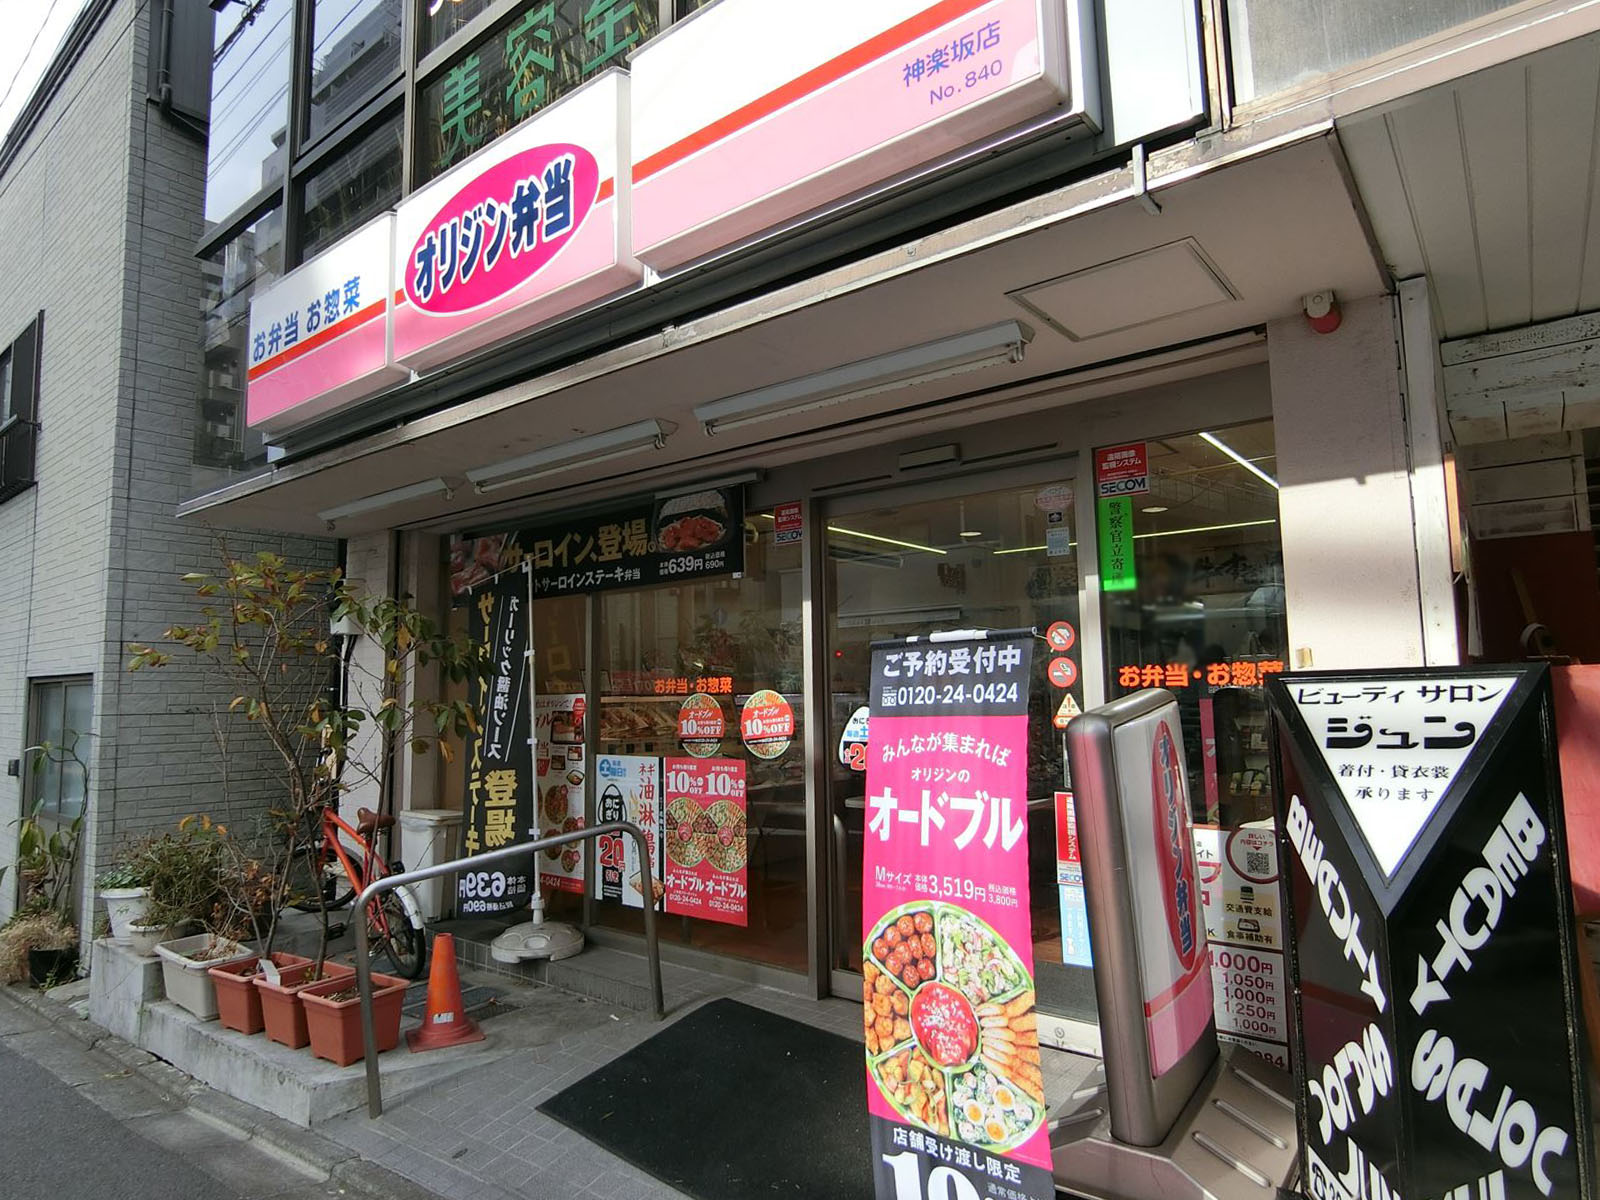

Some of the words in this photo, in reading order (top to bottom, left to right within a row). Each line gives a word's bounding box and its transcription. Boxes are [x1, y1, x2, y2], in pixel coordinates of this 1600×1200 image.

[902, 20, 1000, 87] 神楽坂店
[929, 59, 1002, 105] No.840
[413, 153, 576, 302] オリジン弁当
[252, 315, 299, 362] お弁当
[305, 275, 361, 330] お惣菜
[1101, 478, 1146, 494] SECOM
[668, 556, 703, 573] 639円
[883, 645, 1021, 677] ご予約受付中
[654, 677, 733, 694] お弁当・お惣菜
[898, 682, 1018, 705] 0120-24-0424
[1297, 686, 1405, 705] ビューティ
[1417, 684, 1503, 703] サロン
[1326, 716, 1476, 749] ジュン
[882, 732, 1011, 767] みんなが集まれば
[911, 767, 971, 783] オリジンの
[1355, 786, 1434, 801] 承ります
[868, 786, 1025, 851] オードブル
[1160, 733, 1193, 956] オリジン弁当
[875, 865, 912, 885] Mサイズ
[1060, 873, 1081, 882] SECO
[705, 879, 747, 898] オードブル
[929, 874, 986, 902] 3,519円
[1226, 903, 1272, 917] 交通費支給
[893, 1127, 1022, 1184] 店舗受け渡し限定
